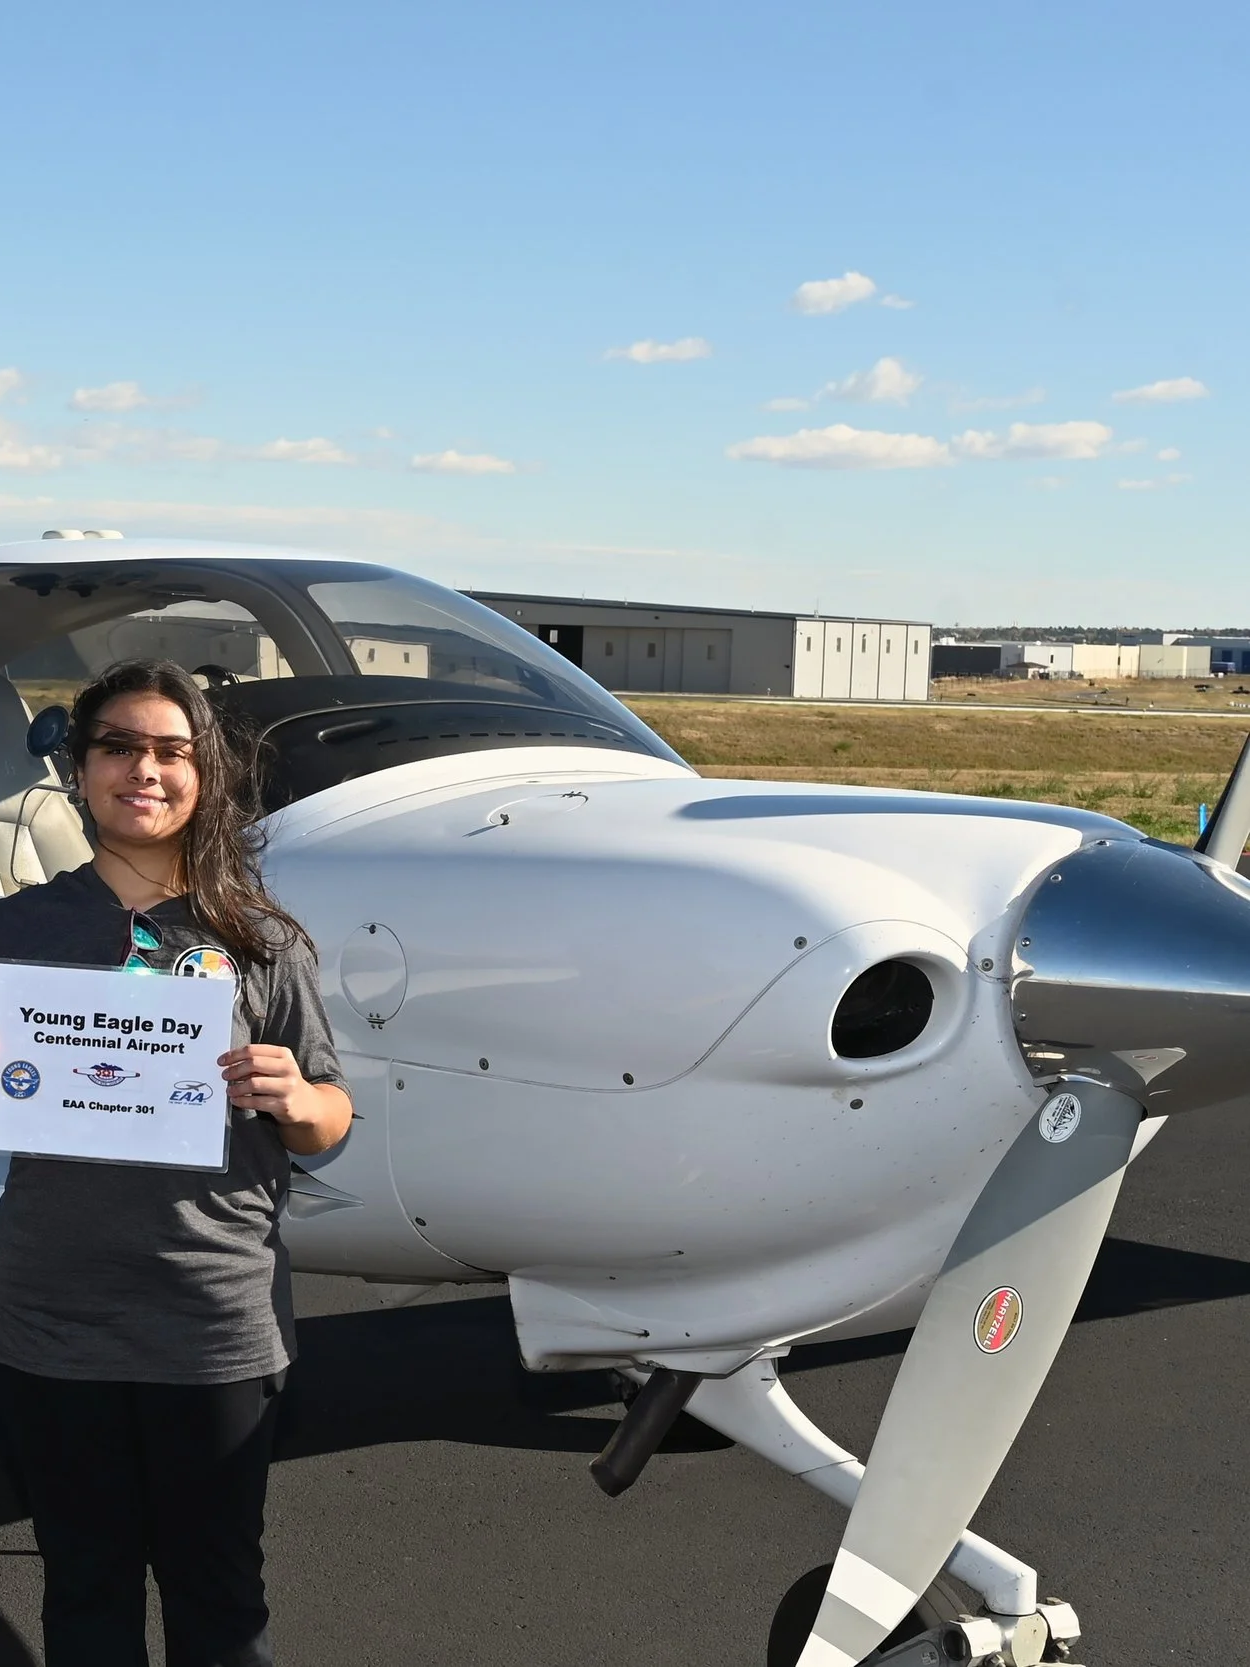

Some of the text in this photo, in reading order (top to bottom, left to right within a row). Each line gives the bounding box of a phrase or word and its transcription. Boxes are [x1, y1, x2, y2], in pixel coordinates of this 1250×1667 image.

[19, 1007, 203, 1039] Young Eagle Day
[34, 1031, 185, 1055] Centennial Airport
[63, 1099, 155, 1114] EAA Chapter 301
[169, 1090, 205, 1103] EAA
[983, 1291, 1014, 1346] HARTZELL
